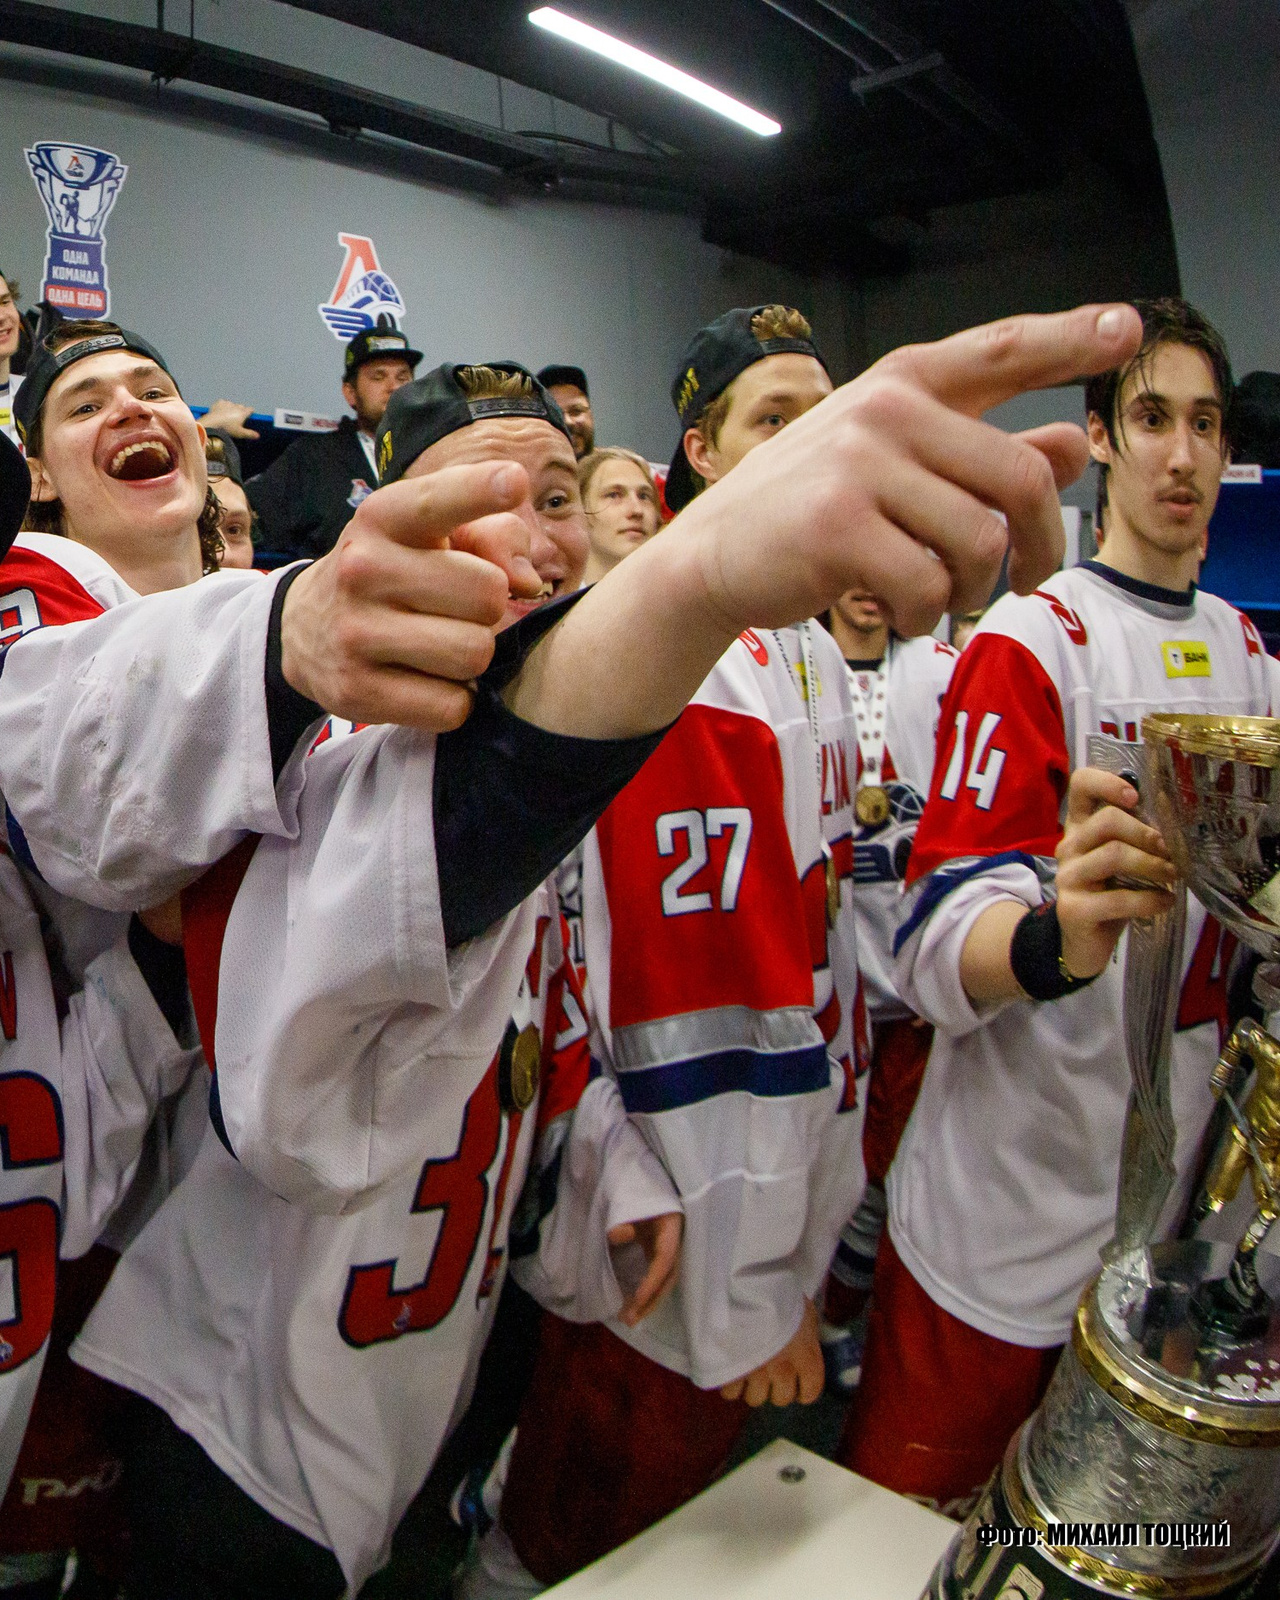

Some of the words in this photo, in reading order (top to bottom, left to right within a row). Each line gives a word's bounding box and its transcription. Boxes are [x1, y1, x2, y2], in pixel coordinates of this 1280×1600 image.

[62, 249, 89, 266] ОДНА
[52, 265, 100, 285] КОМАНДА
[48, 288, 75, 305] ОДНА
[77, 291, 103, 308] ЦЕЛЬ
[939, 709, 1007, 812] 14
[655, 806, 753, 918] 27
